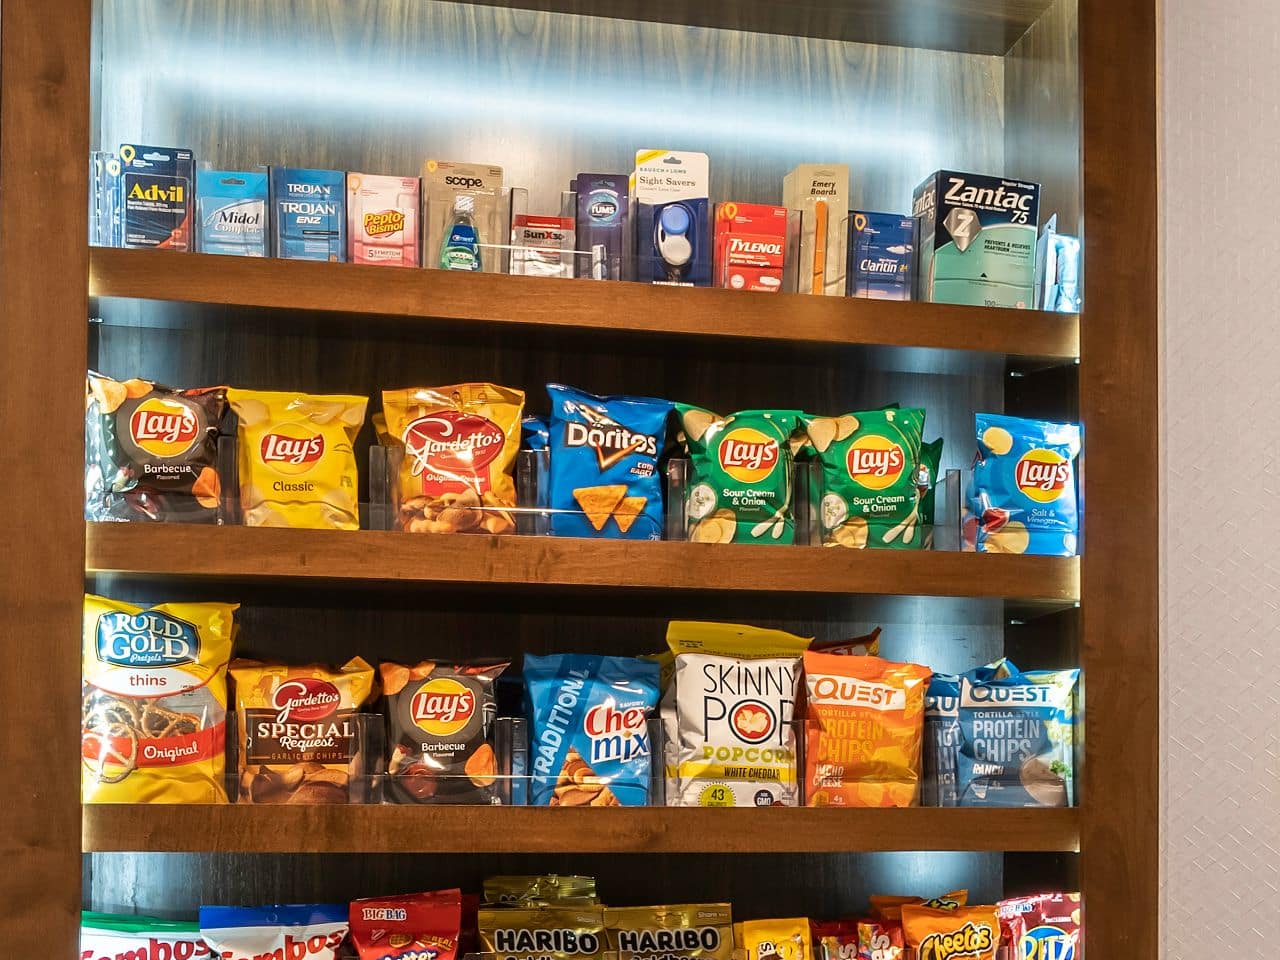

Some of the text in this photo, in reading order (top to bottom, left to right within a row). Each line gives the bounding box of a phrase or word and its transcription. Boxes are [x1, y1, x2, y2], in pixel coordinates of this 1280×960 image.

[287, 184, 330, 194] TROJAN
[445, 175, 483, 188] scope
[640, 176, 695, 187] Sight Savers
[812, 180, 836, 189] Emery
[129, 183, 183, 202] Advil
[811, 187, 836, 196] Boards
[945, 177, 1033, 211] Zantac
[279, 202, 335, 215] TROJAN
[591, 205, 615, 214] TUMS
[220, 209, 260, 225] Midol
[296, 216, 322, 224] ENZ
[1011, 211, 1029, 224] 75
[368, 222, 404, 235] Bismol
[730, 238, 782, 255] TYLENOL
[860, 259, 897, 273] Claritin
[136, 410, 196, 444] Lay's
[567, 420, 656, 456] Doritos
[264, 433, 321, 464] Lay's
[404, 418, 501, 477] Gardetto's
[723, 438, 775, 469] Lay's
[144, 463, 191, 474] Barbecue
[852, 447, 901, 476] Lay's
[1019, 460, 1067, 490] Lay's
[273, 481, 313, 492] Classic
[723, 488, 775, 498] Sour Cream
[732, 497, 766, 506] & Onion
[853, 495, 904, 505] Sour Cream
[872, 503, 896, 512] Onion
[115, 612, 184, 638] ROLD
[105, 632, 189, 659] GOLD
[130, 653, 162, 663] Pretzels
[130, 674, 167, 687] thins
[703, 662, 796, 694] SKINNY
[814, 677, 896, 705] QUEST
[969, 684, 1050, 702] QUEST
[273, 682, 340, 723] Gardetto's
[415, 692, 471, 721] Lay's
[258, 723, 355, 738] SPECIAL
[973, 720, 1040, 739] PROTEIN
[144, 741, 198, 762] Original
[280, 736, 334, 752] Request
[422, 742, 465, 751] Barbecue
[594, 731, 649, 763] mix
[973, 739, 1034, 762] CHIPS
[724, 767, 781, 779] WHITE CHEDDAR
[711, 789, 724, 800] 43
[362, 908, 407, 920] BIG BAG
[496, 930, 599, 954] HARIBO
[619, 927, 719, 952] HARIBO
